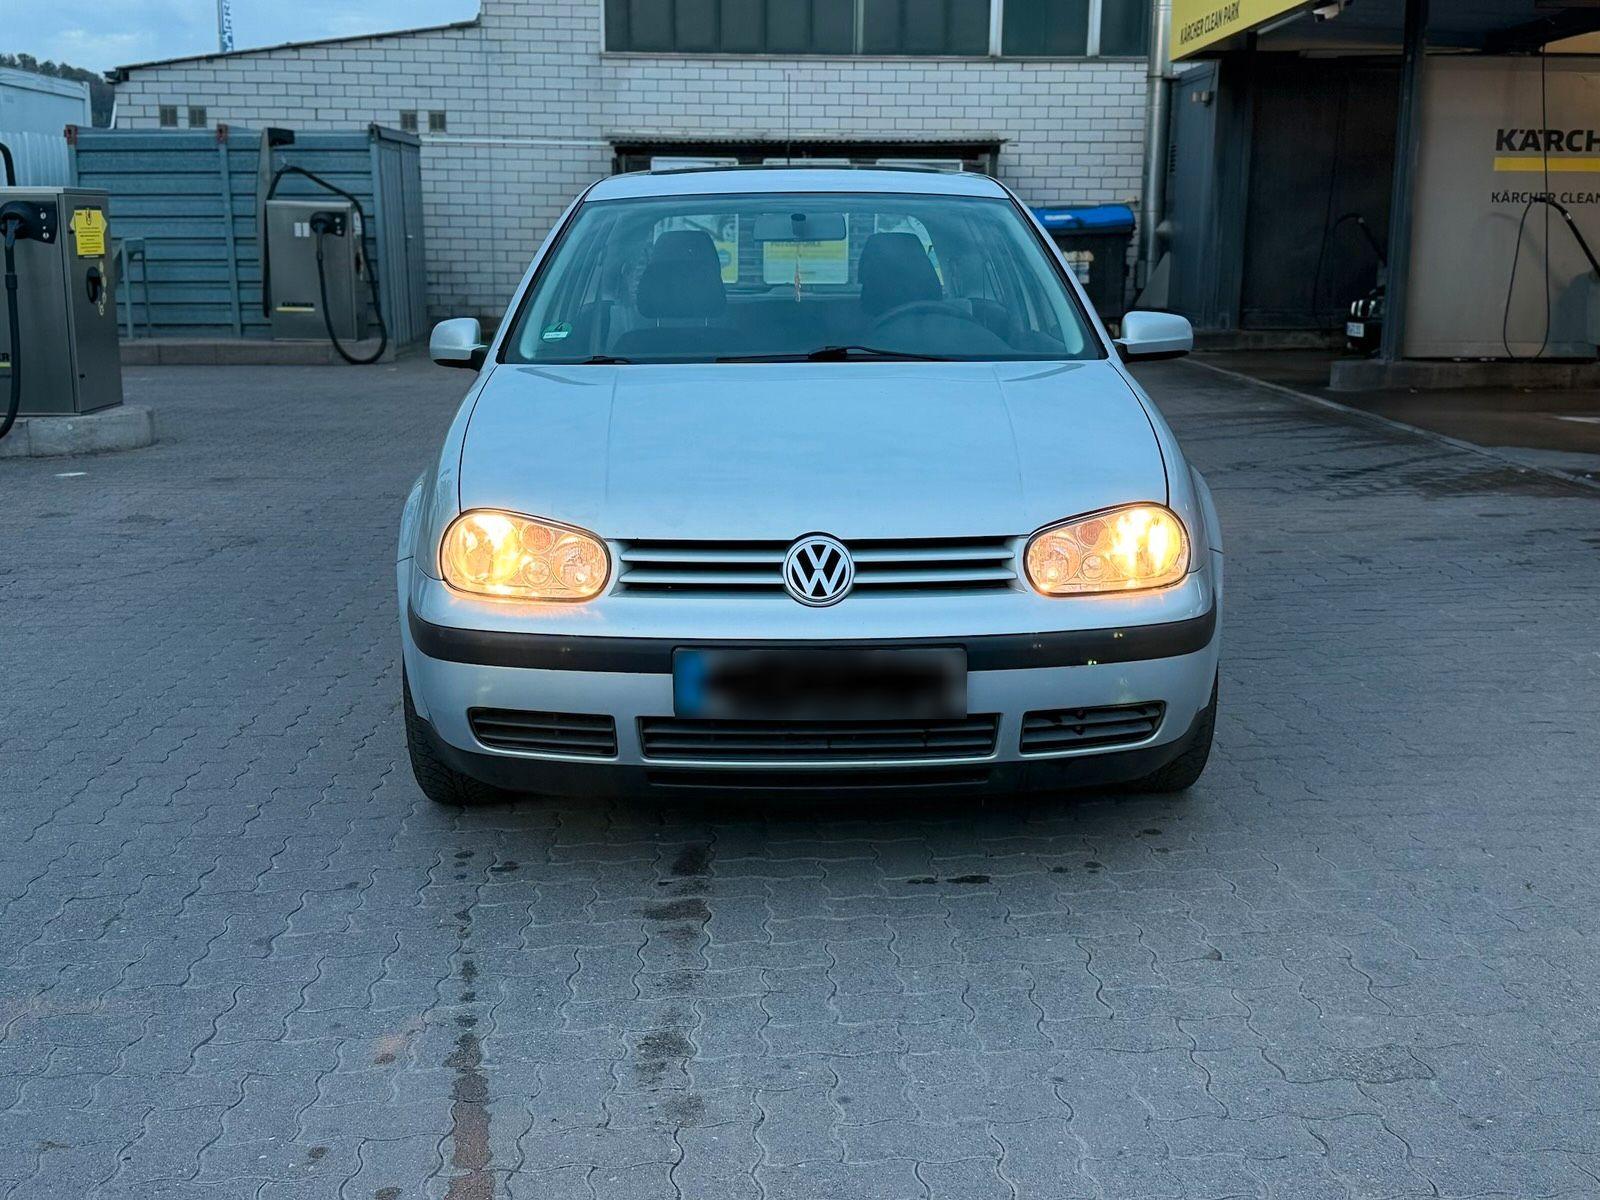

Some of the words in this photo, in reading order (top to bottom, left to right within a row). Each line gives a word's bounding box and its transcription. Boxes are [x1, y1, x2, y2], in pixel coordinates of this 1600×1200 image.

[1204, 10, 1222, 34] CLEAN
[1222, 0, 1240, 26] PARK
[787, 537, 851, 602] VW
